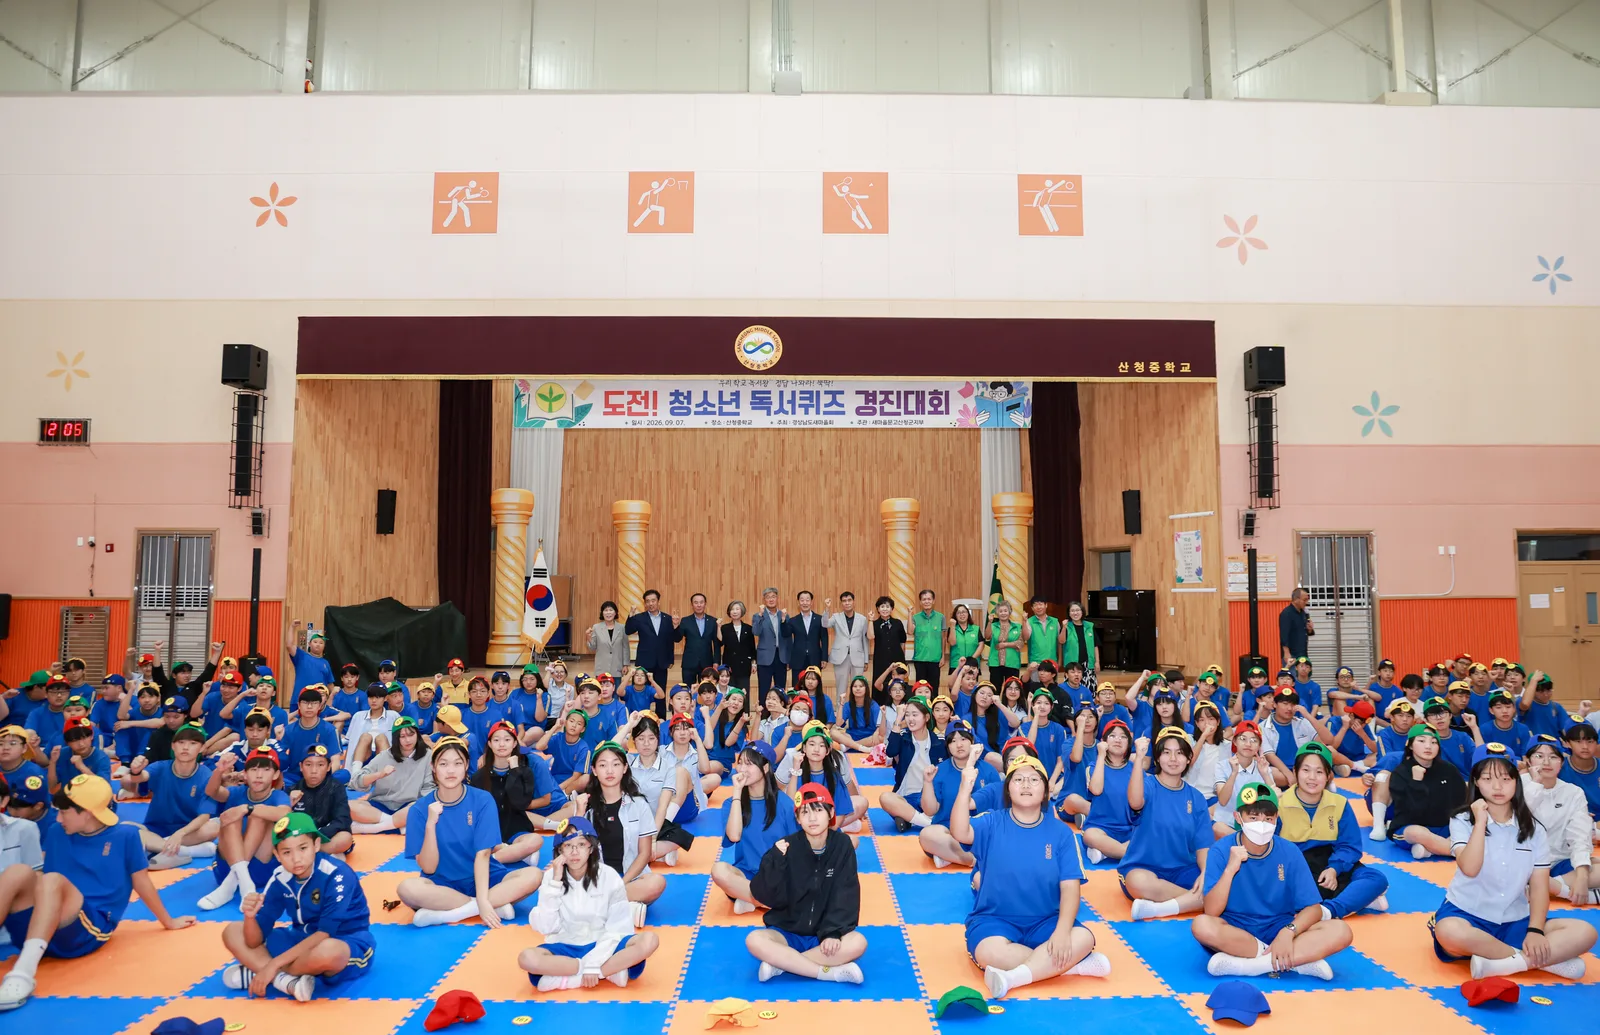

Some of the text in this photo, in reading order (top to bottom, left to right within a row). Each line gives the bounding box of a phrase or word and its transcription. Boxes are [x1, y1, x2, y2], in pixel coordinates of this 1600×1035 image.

[1118, 361, 1192, 373] 산청중학교
[603, 389, 950, 417] 도전! 청소년 독서퀴즈 경진대회
